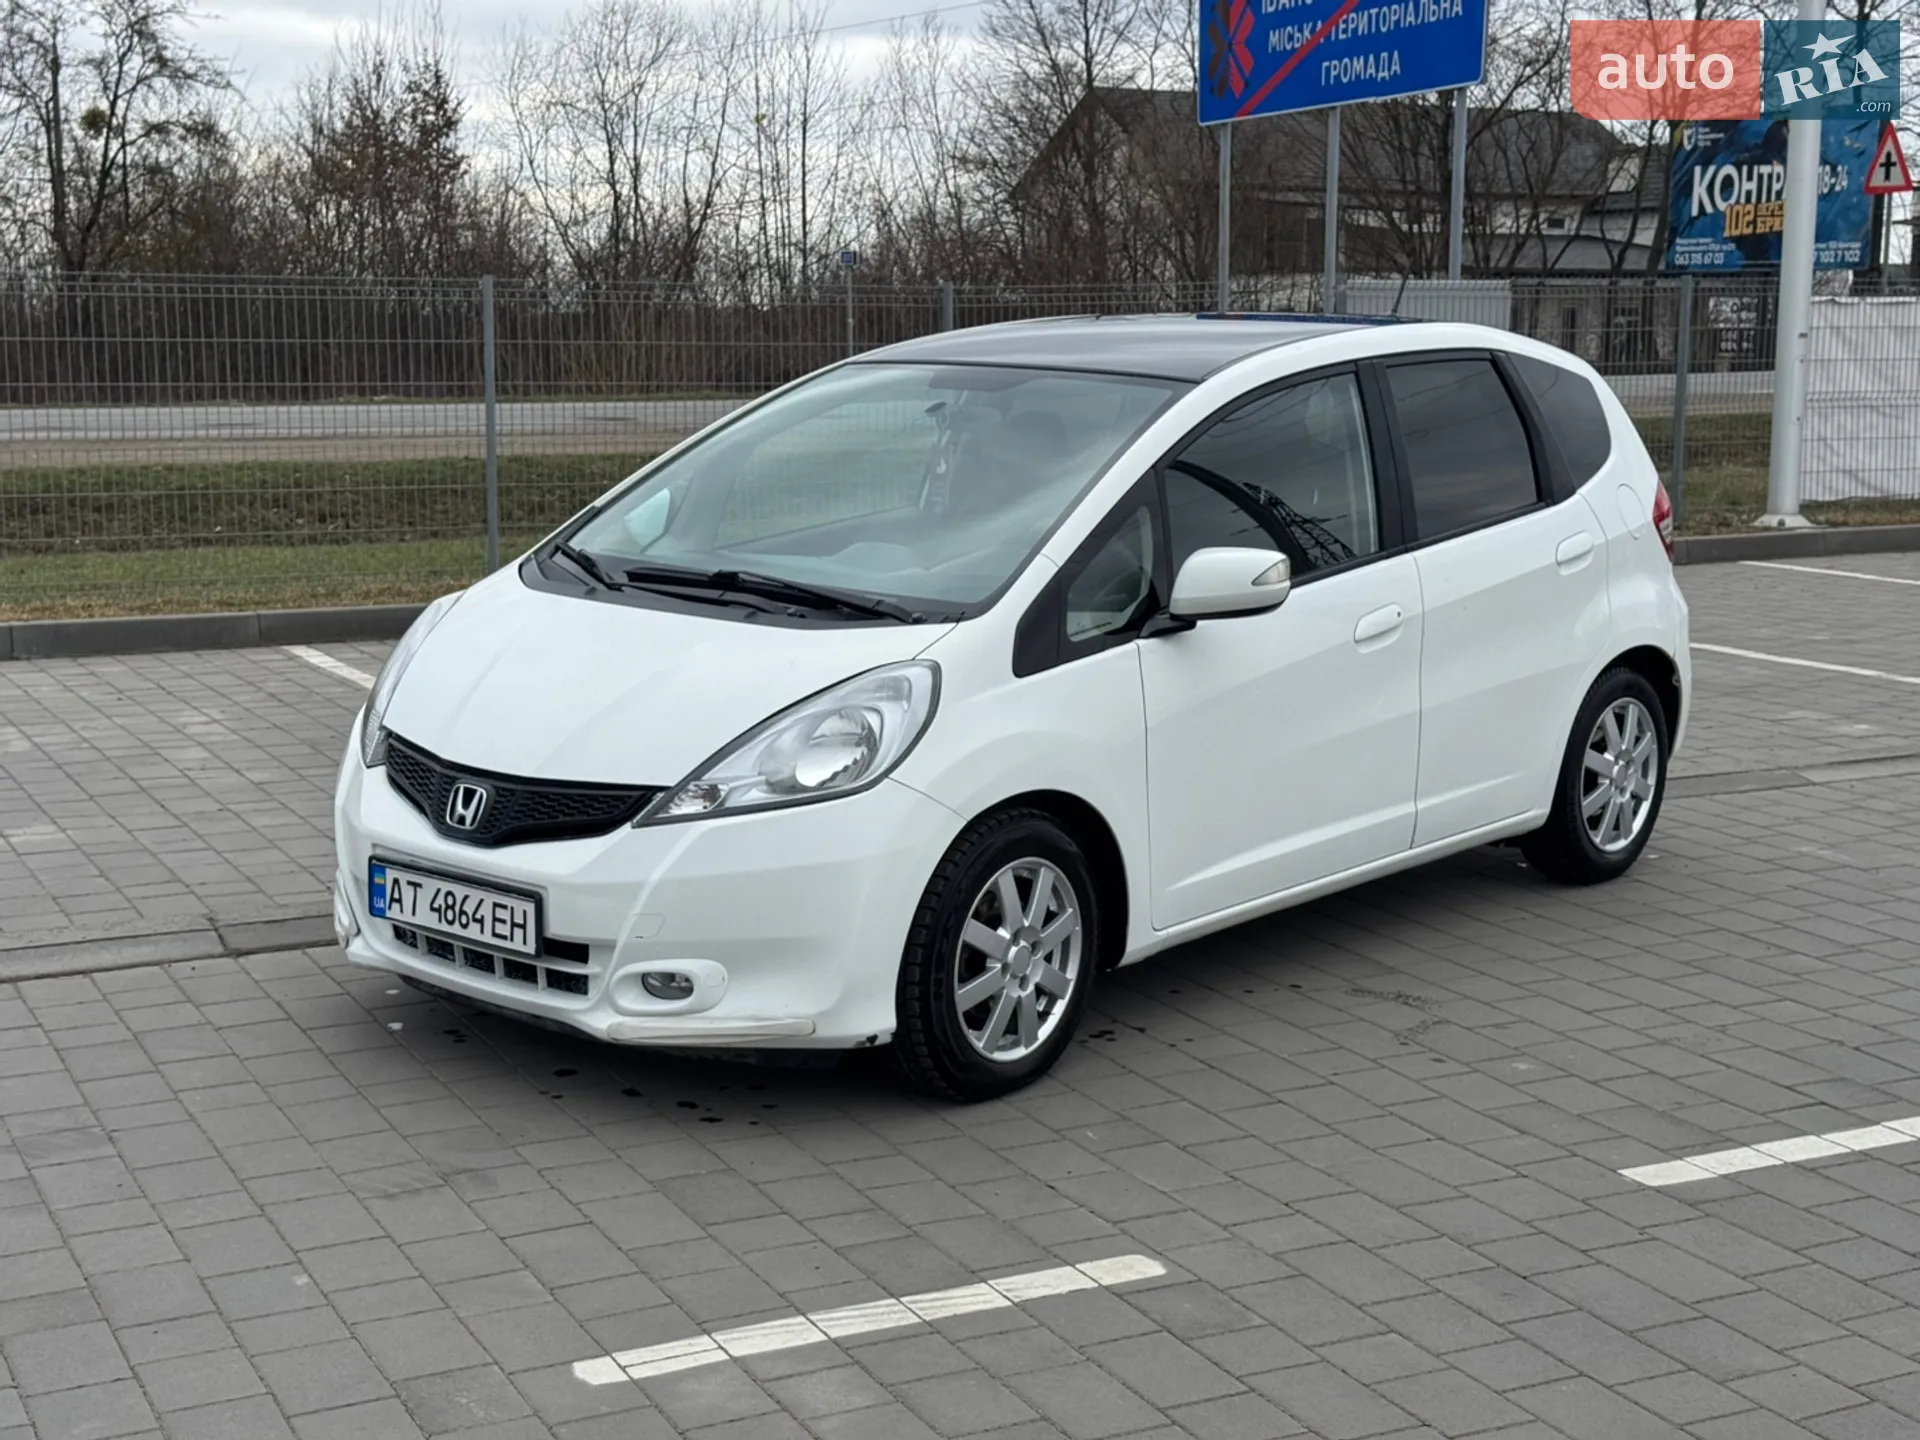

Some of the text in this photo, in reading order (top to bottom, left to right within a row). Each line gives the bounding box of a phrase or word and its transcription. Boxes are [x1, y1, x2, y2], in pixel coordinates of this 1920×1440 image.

[1321, 50, 1401, 86] ГРОМАДА
[1691, 163, 1787, 217] КОНТР
[1723, 203, 1756, 238] 102
[373, 896, 385, 909] UA
[388, 877, 528, 946] AT 4864 EH
